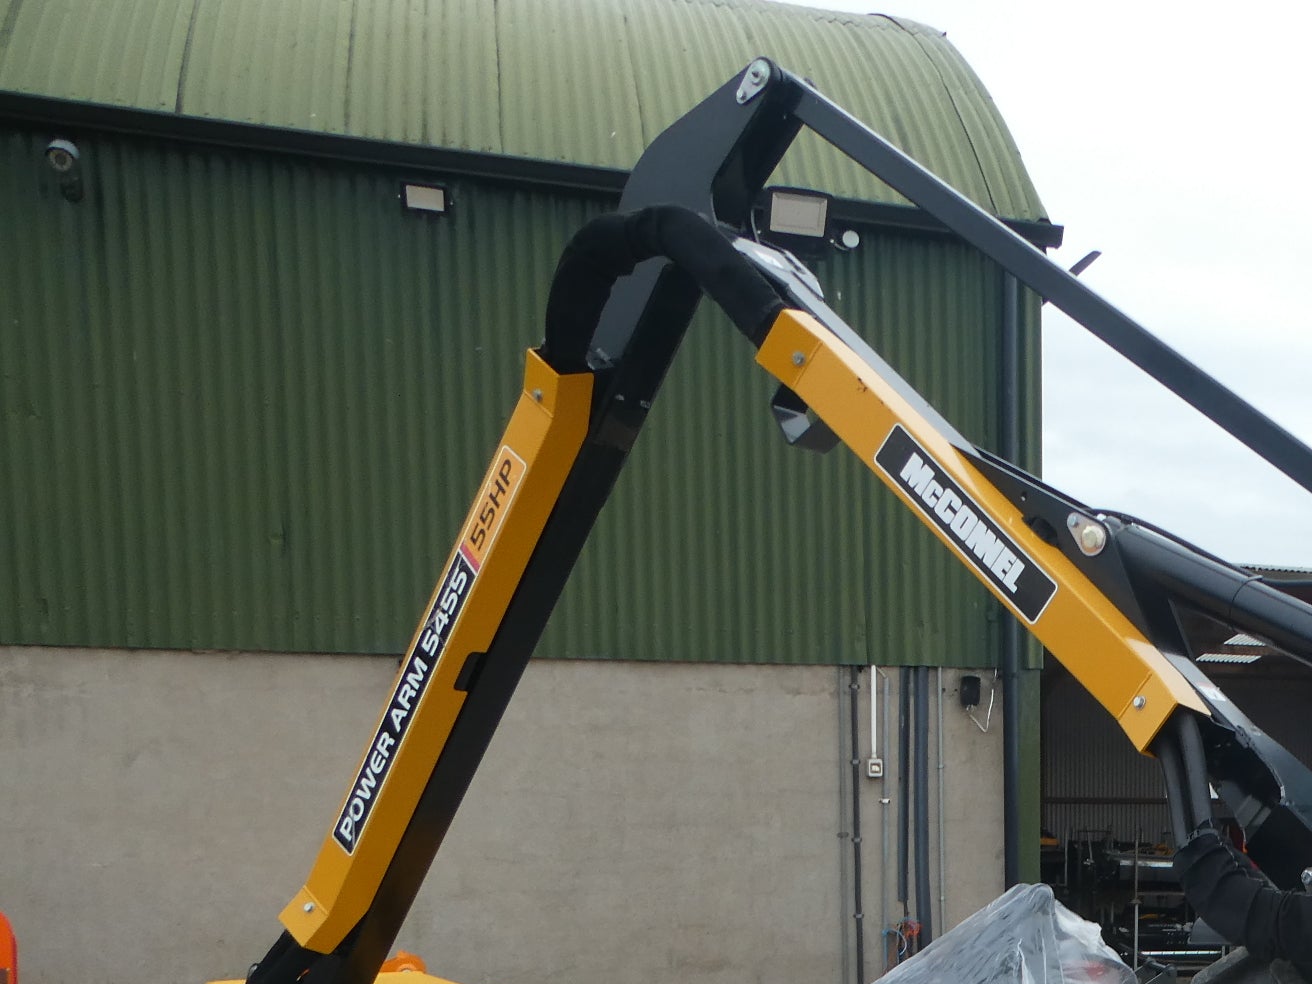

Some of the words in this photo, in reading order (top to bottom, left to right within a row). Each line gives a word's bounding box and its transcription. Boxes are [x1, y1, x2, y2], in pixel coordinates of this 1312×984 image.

[340, 732, 395, 843] POWER
[391, 658, 428, 734] ARM
[421, 568, 468, 659] 5455
[469, 458, 513, 552] 55HP
[899, 452, 1025, 594] McCONNEL
